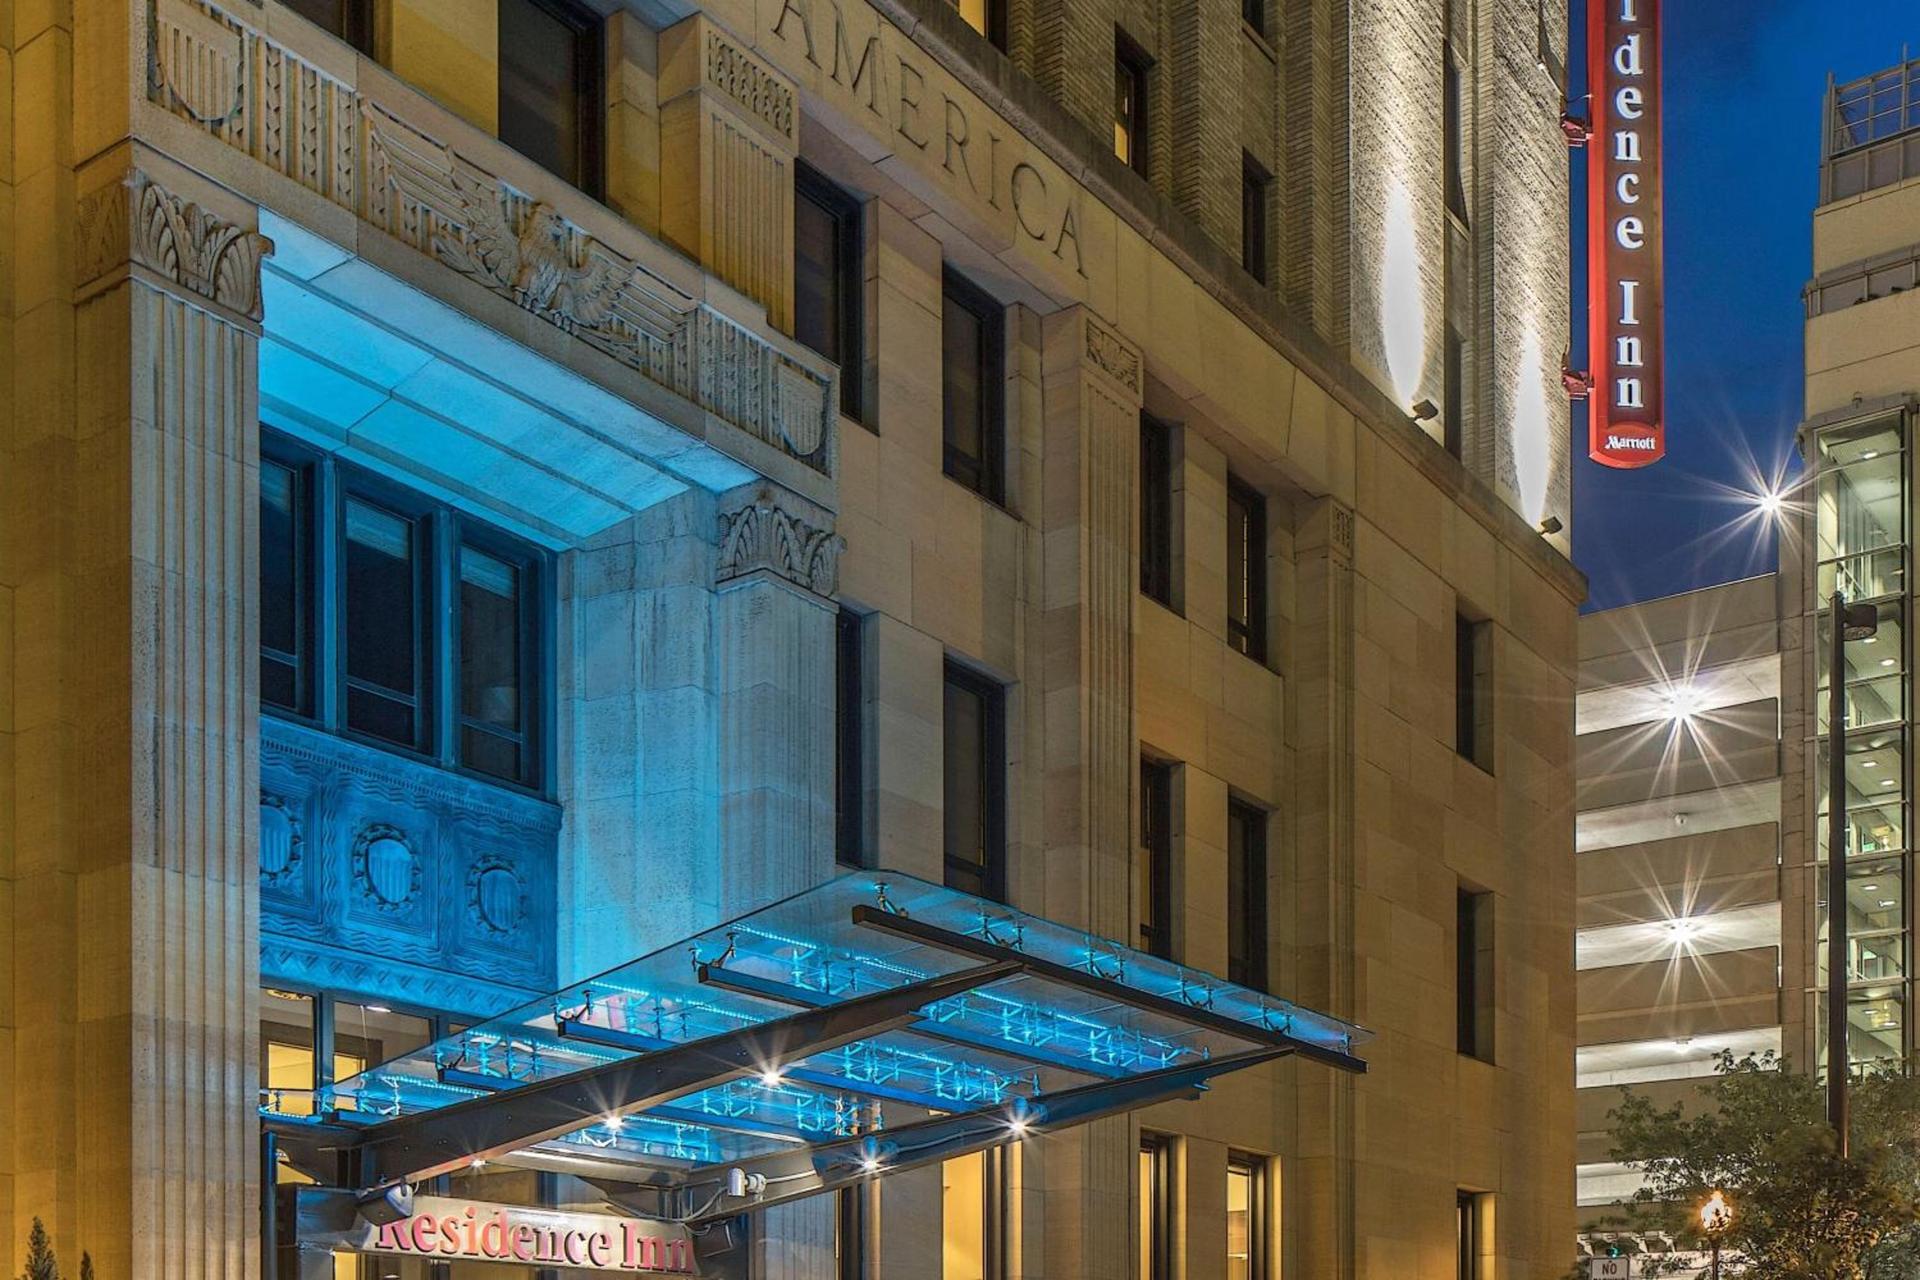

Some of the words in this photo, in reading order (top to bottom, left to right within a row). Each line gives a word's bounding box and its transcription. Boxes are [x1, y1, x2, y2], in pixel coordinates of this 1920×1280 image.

[770, 0, 1089, 280] AMERICA
[1616, 281, 1643, 408] Inn
[1604, 435, 1656, 450] Marriott
[620, 1222, 694, 1274] Inn
[1602, 1263, 1617, 1275] NO
